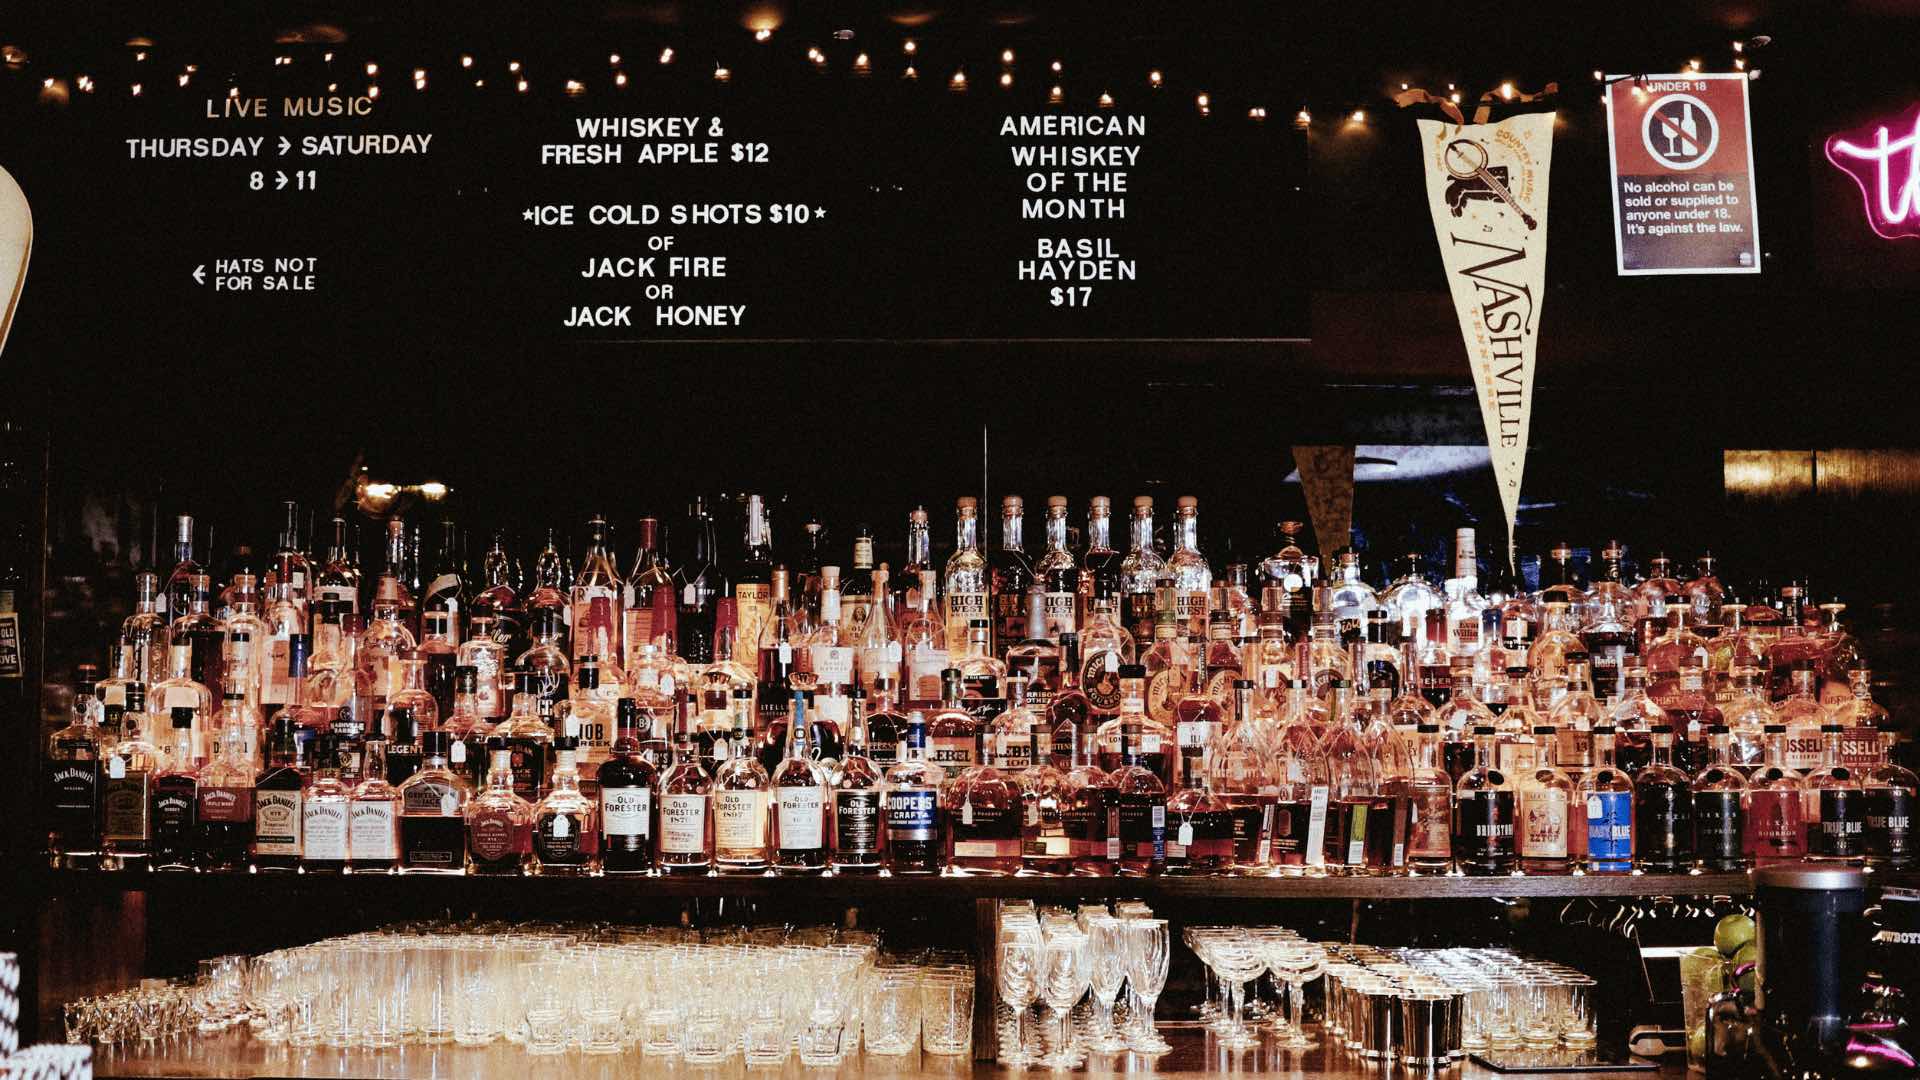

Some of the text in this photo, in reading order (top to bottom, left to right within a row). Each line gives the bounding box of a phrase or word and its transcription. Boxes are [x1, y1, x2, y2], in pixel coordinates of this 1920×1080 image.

[1649, 82, 1707, 92] UNDER 18
[206, 96, 373, 118] LIVE MUSIC
[576, 116, 724, 138] WHISKEY &
[1000, 115, 1145, 136] AMERICAN
[126, 134, 433, 159] THURSDAY SATURDAY
[541, 142, 769, 165] FRESH APPLE $12
[1011, 146, 1141, 166] WHISKEY
[249, 170, 317, 190] 8 11
[1026, 172, 1128, 192] OF THE
[1624, 181, 1735, 193] No alcohol can be
[1625, 194, 1739, 208] sold or supplied to
[534, 204, 810, 225] ICE COLD SHOTS $10
[1022, 199, 1125, 219] MONTH
[1626, 208, 1732, 223] anyone under 18.
[1627, 221, 1744, 236] It's against the law.
[647, 236, 675, 251] OF
[1038, 238, 1120, 258] BASIL
[216, 258, 318, 273] HATS NOT
[581, 257, 727, 277] JACK FIRE
[1018, 260, 1136, 280] HAYDEN
[216, 276, 316, 291] FOR SALE
[645, 284, 674, 300] OR
[1050, 286, 1092, 307] $17
[563, 305, 747, 327] JACK HONEY
[1450, 232, 1533, 448] NASHVILLE
[738, 591, 769, 600] TAYLOR
[950, 595, 983, 605] HIGH
[1177, 596, 1205, 605] HIGH
[951, 605, 983, 613] WEST
[1177, 606, 1207, 616] WEST
[387, 745, 424, 754] LEGENT
[932, 749, 971, 761] EBEL
[617, 795, 635, 804] OLD
[673, 800, 688, 809] OLD
[725, 795, 740, 803] OLD
[850, 799, 866, 808] OLD
[605, 802, 647, 812] FORESTER
[663, 807, 700, 816] FORESTER
[839, 806, 876, 815] FORESTER
[1846, 821, 1862, 833] BLUE
[1888, 816, 1910, 829] BLUE
[1612, 825, 1631, 839] BLUE
